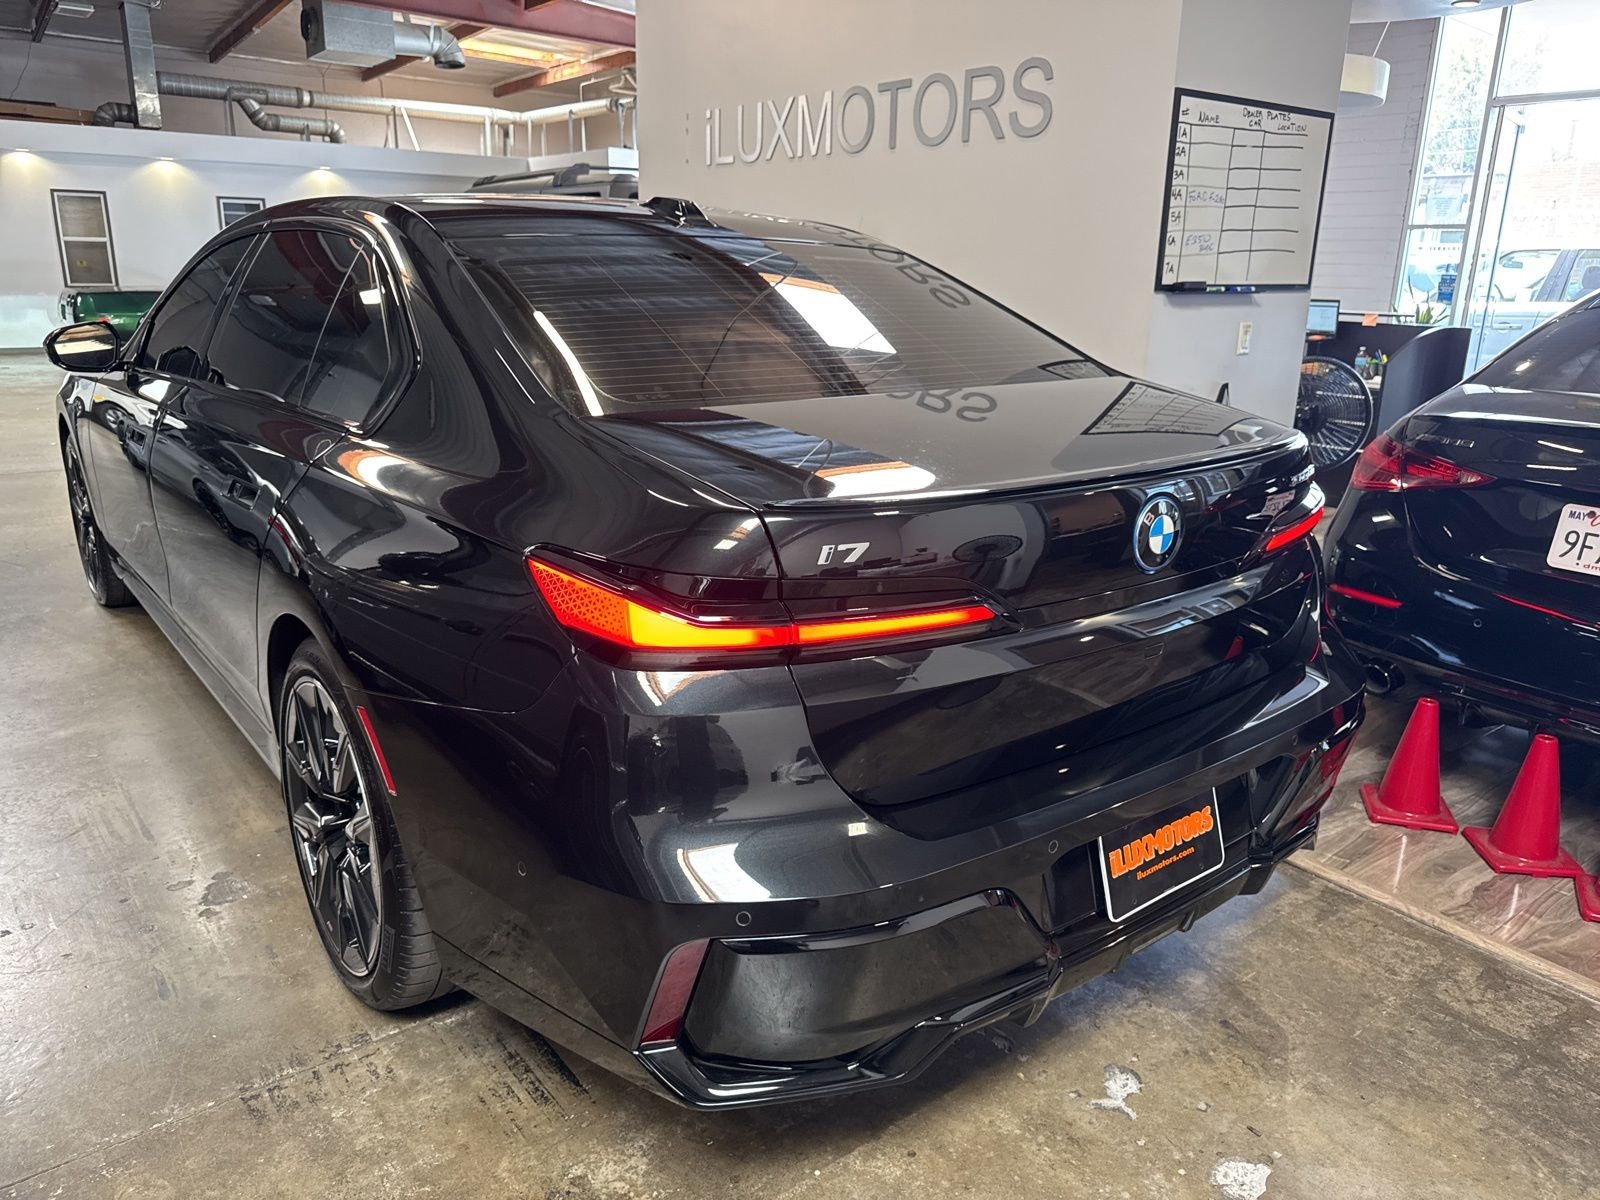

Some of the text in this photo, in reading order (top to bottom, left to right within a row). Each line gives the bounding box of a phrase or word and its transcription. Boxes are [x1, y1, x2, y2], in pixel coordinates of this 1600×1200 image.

[705, 56, 1054, 167] iLUXMOTORS
[1198, 111, 1221, 124] NAME
[1266, 110, 1292, 122] PLATES
[1248, 119, 1262, 129] CAR
[1175, 146, 1186, 157] 2A
[1173, 169, 1185, 180] 3A
[1568, 510, 1587, 521] MAY
[1559, 530, 1600, 564] 9F
[817, 542, 870, 565] i7
[1136, 847, 1195, 881] iluxmotors.com
